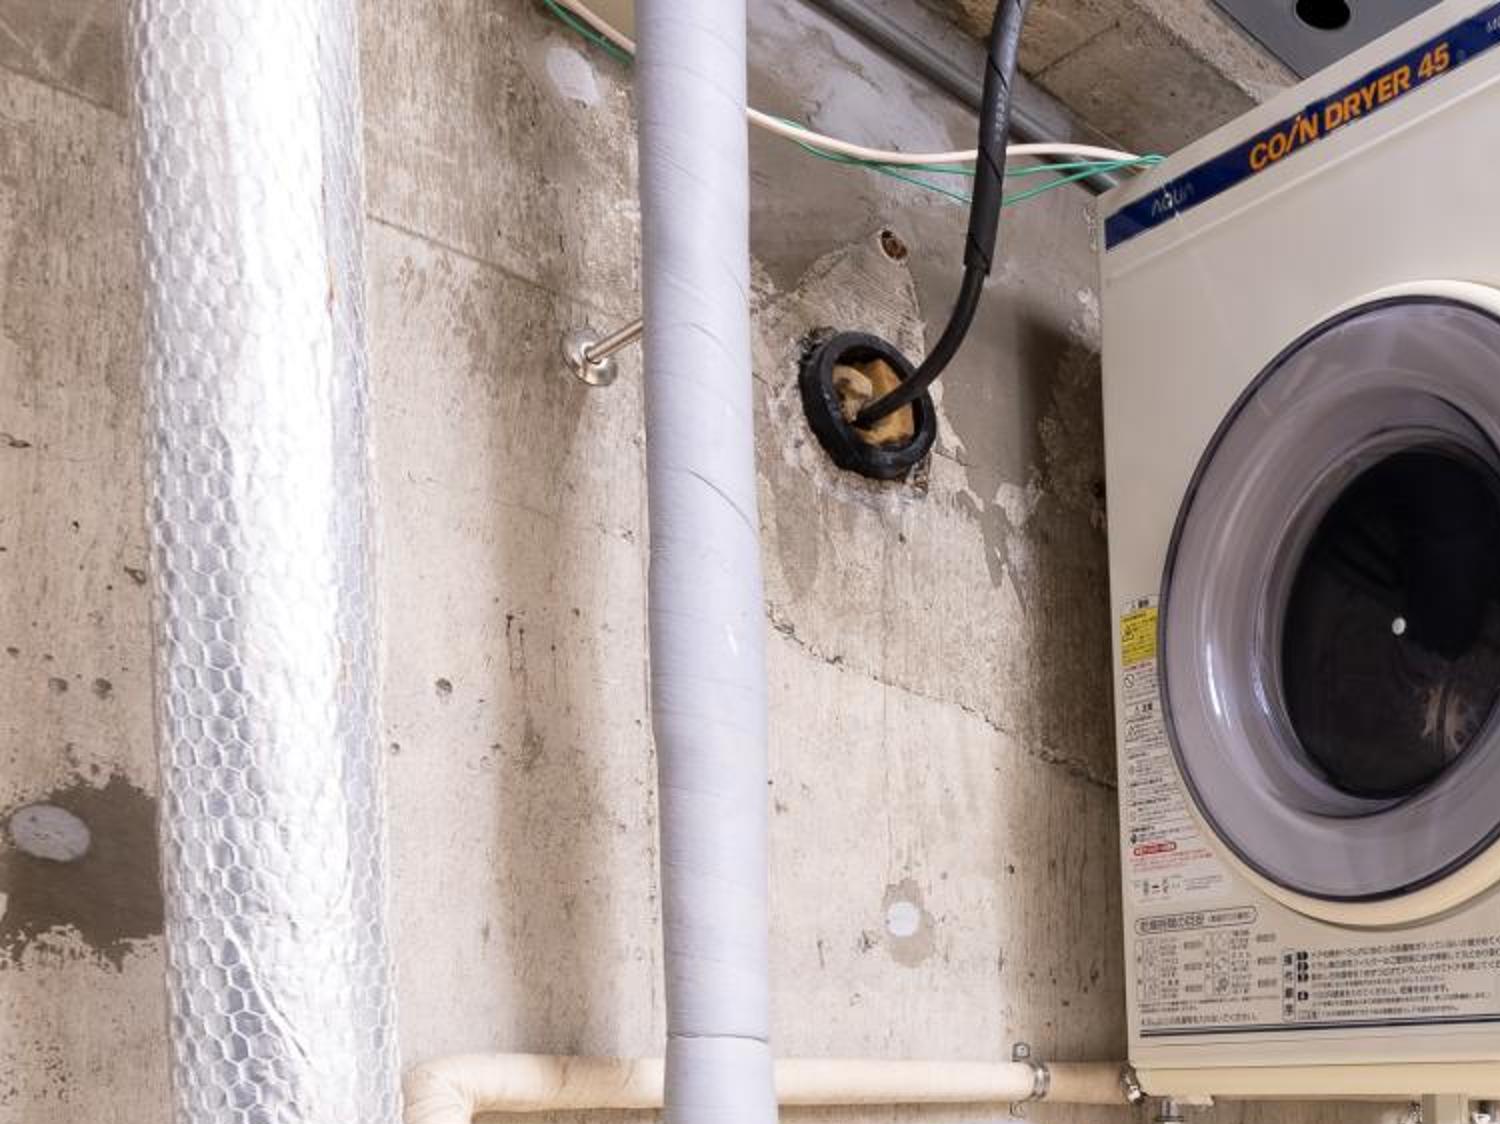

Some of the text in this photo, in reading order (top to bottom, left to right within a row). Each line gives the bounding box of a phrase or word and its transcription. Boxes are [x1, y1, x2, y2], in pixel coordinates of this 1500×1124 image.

[1323, 69, 1412, 134] DRYER
[1417, 42, 1451, 79] 45
[1151, 182, 1195, 217] AQUA
